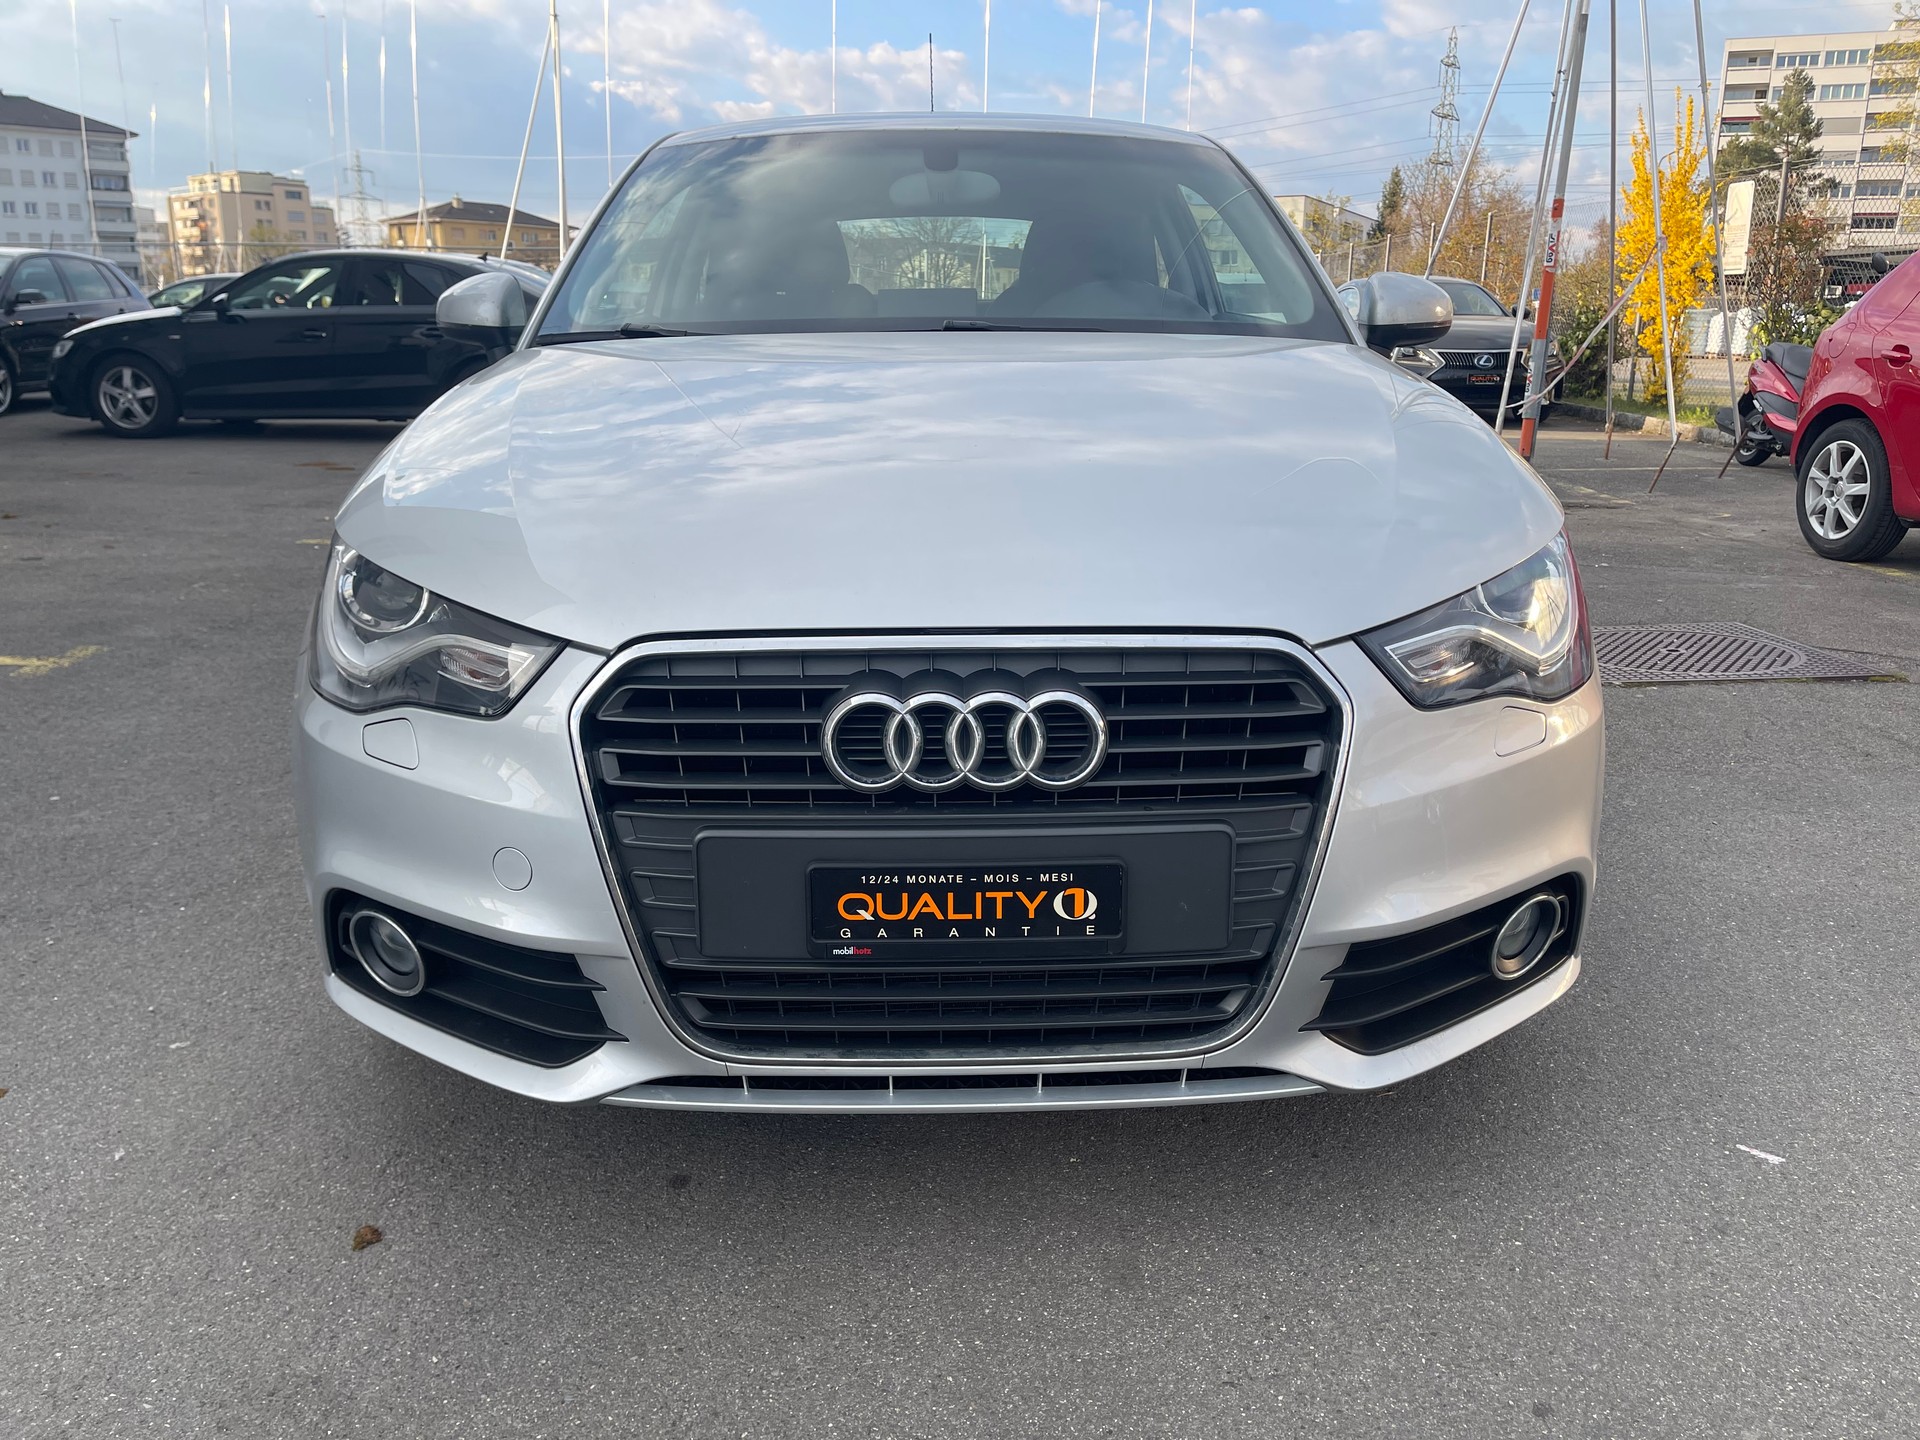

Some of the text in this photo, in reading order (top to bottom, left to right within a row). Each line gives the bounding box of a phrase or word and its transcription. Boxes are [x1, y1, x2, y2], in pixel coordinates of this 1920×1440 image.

[861, 875, 899, 884] 12/24
[906, 875, 963, 884] MONATE
[984, 873, 1019, 883] MOIS
[1040, 873, 1073, 882] MESI
[840, 925, 1095, 939] GARANTIE
